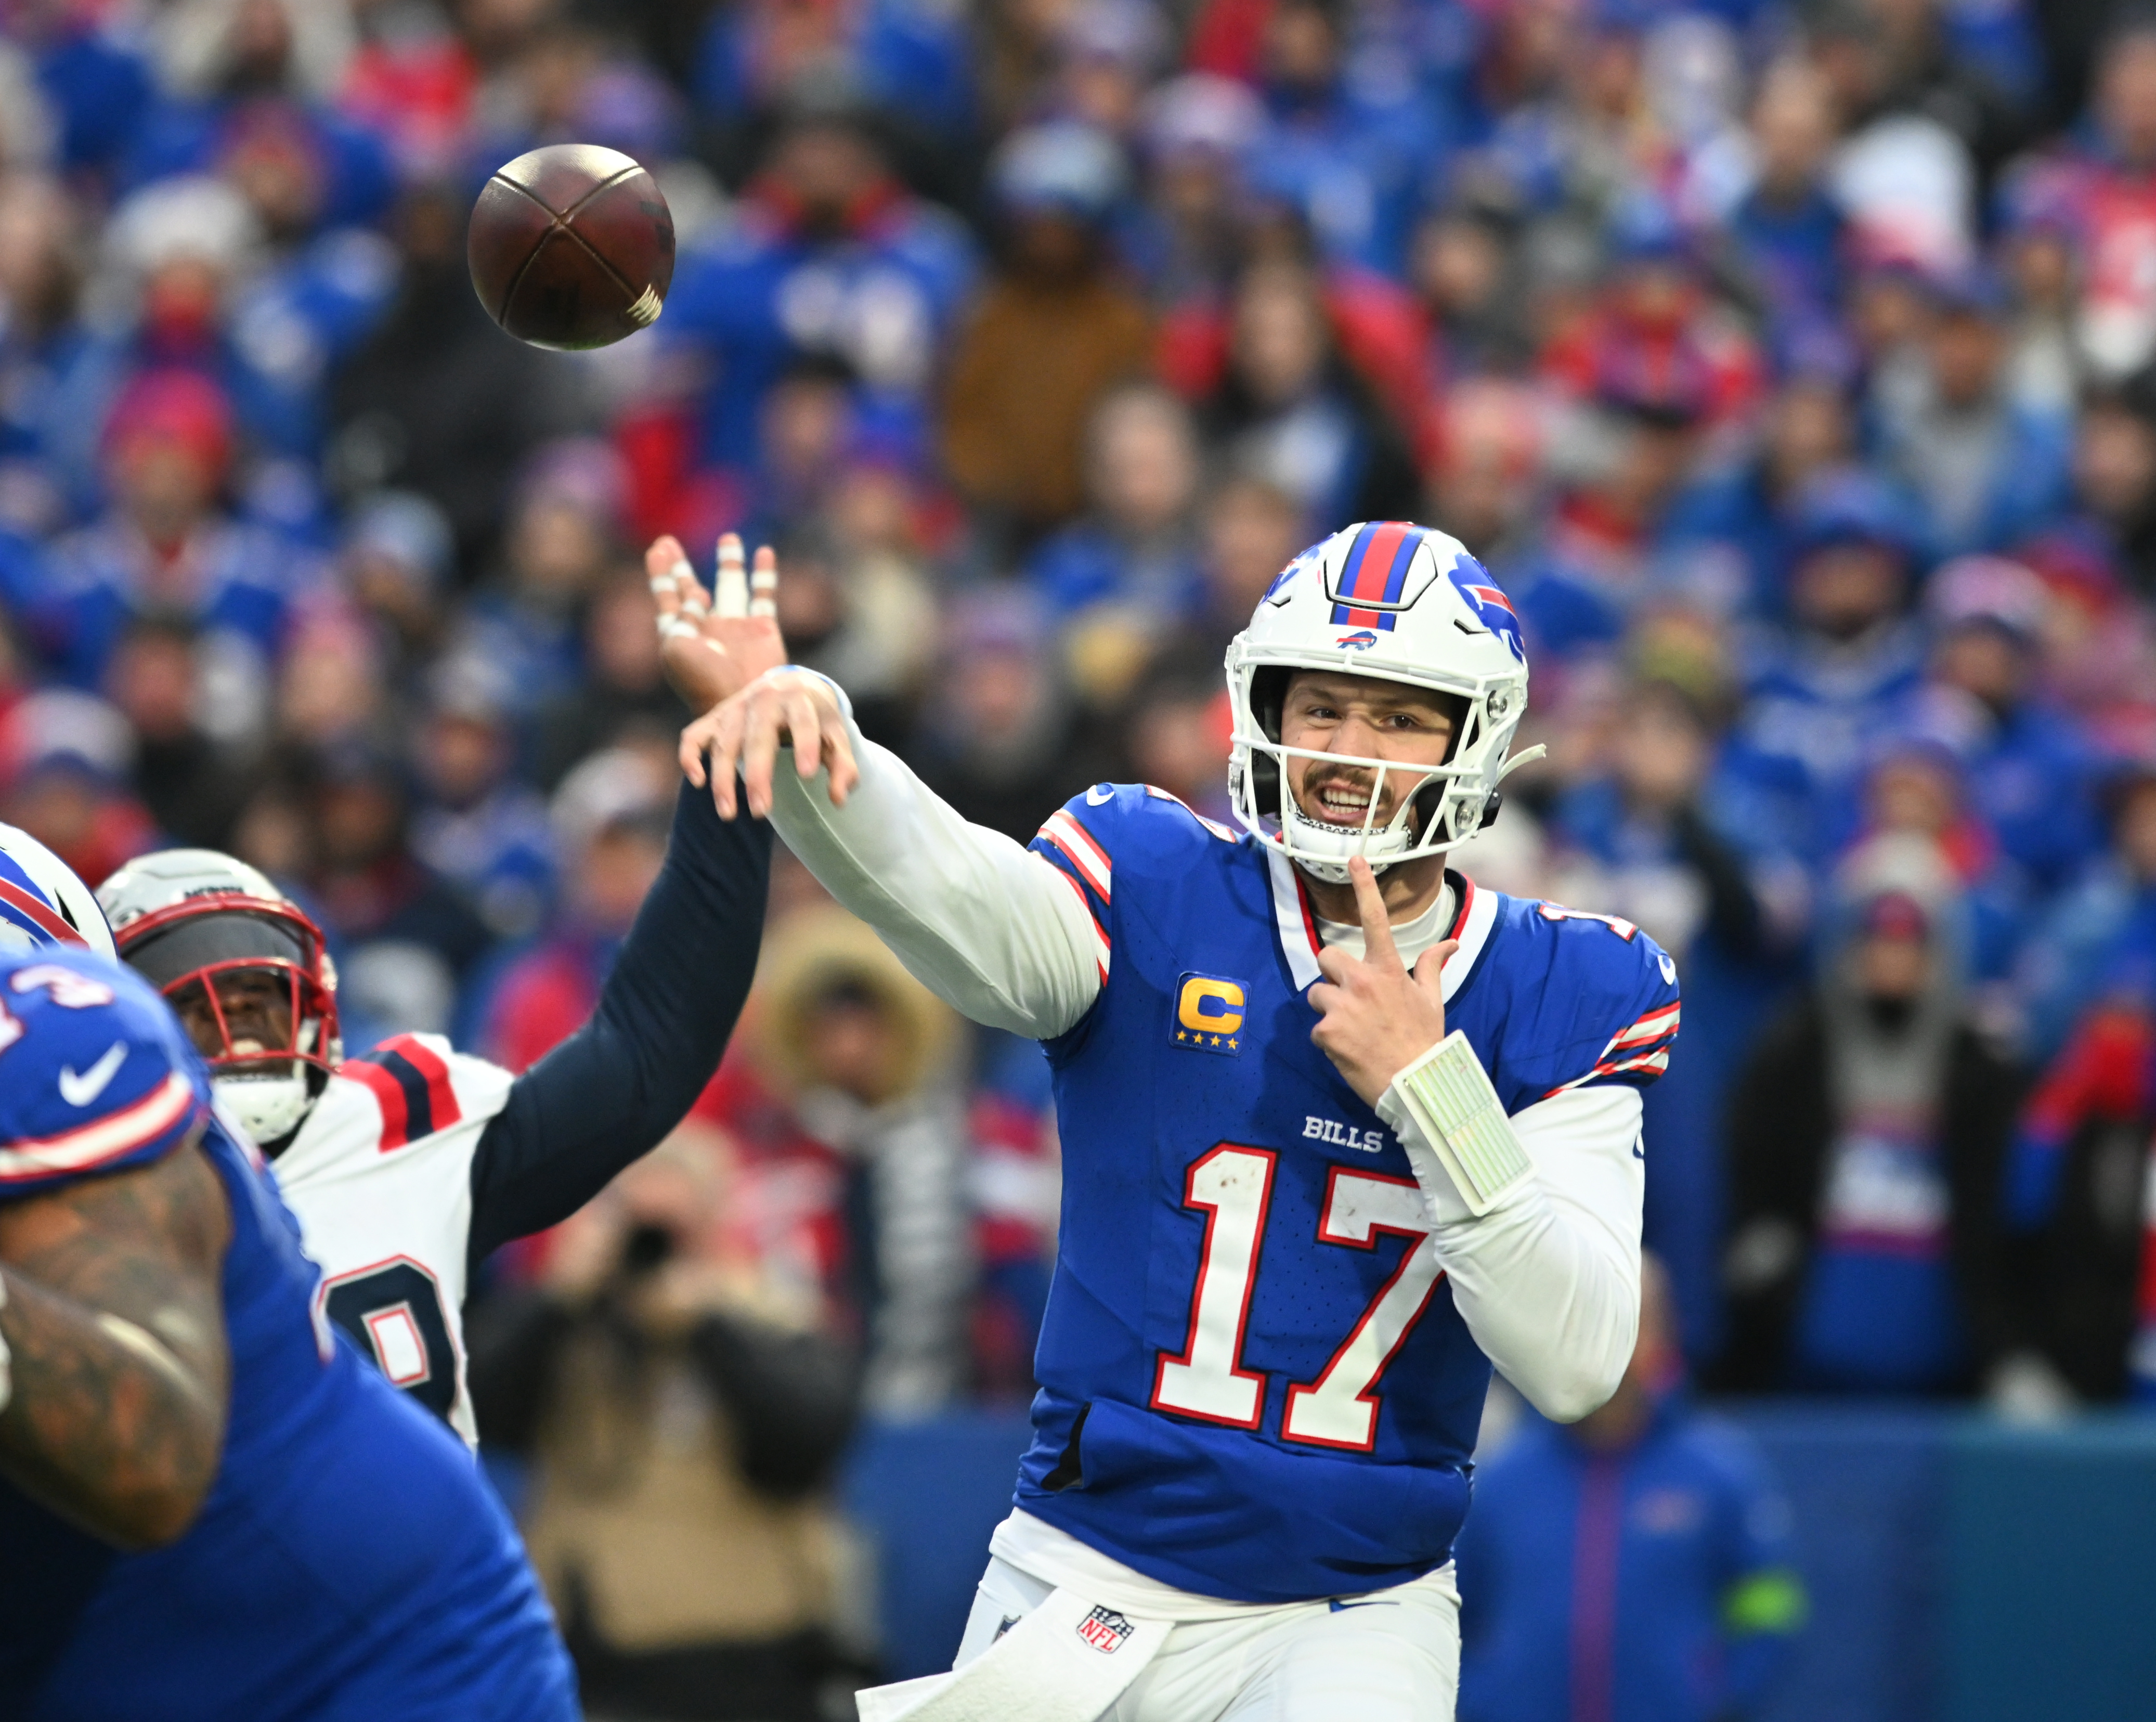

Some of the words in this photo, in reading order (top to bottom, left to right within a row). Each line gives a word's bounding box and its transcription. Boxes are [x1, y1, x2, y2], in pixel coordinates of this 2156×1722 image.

[1178, 978, 1244, 1034] C
[1302, 1116, 1383, 1154] BILLS
[1147, 1140, 1447, 1454] 17
[1080, 1619, 1118, 1651] NFL
